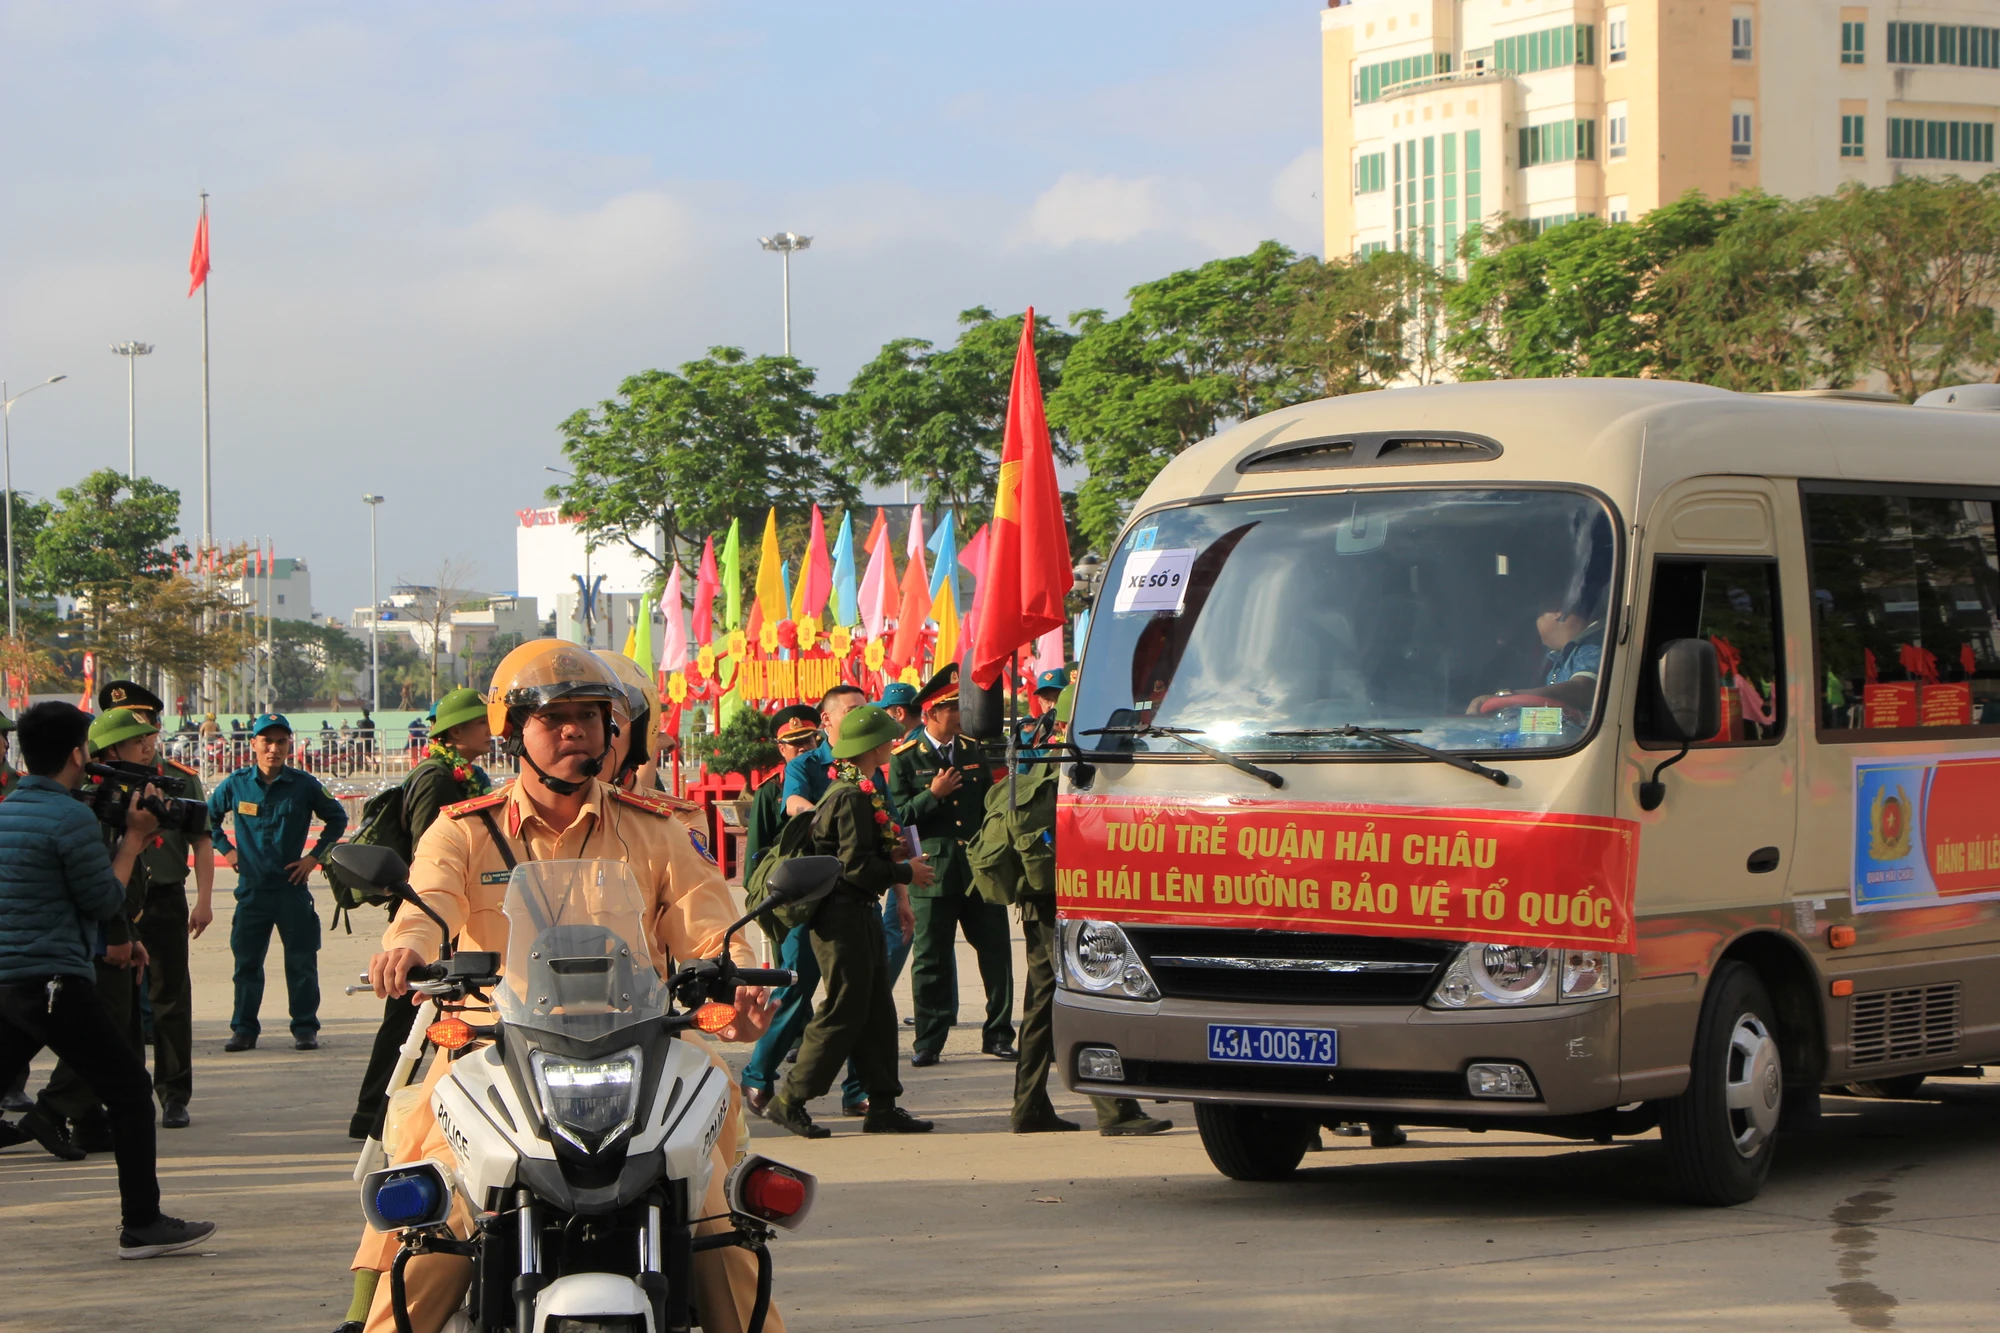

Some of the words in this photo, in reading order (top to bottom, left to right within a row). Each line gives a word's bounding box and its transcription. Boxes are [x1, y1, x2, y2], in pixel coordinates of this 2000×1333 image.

[1128, 576, 1147, 588] XE
[1149, 569, 1171, 587] SỐ
[1171, 574, 1180, 586] 9
[740, 650, 763, 700] CẦU
[766, 659, 796, 699] VINH
[798, 658, 841, 703] QUANG
[1106, 812, 1167, 853] TUỔI
[1175, 816, 1228, 855] TRẺ
[1237, 822, 1325, 865] QUẬN
[1334, 822, 1391, 863] HẢI
[1402, 830, 1497, 869] CHÂU
[1987, 833, 2000, 869] LÊ
[1056, 863, 1088, 898] NG
[1097, 865, 1141, 900] HÁI
[1150, 866, 1204, 903] LÊN
[1213, 869, 1320, 909] ĐƯỜNG
[1331, 872, 1398, 914] BẢO
[1409, 880, 1450, 924] VỆ
[1462, 877, 1509, 920] TỔ
[1518, 885, 1612, 929] QUỐC
[1212, 1028, 1332, 1061] 43A-006.73
[438, 1103, 470, 1161] POLICE
